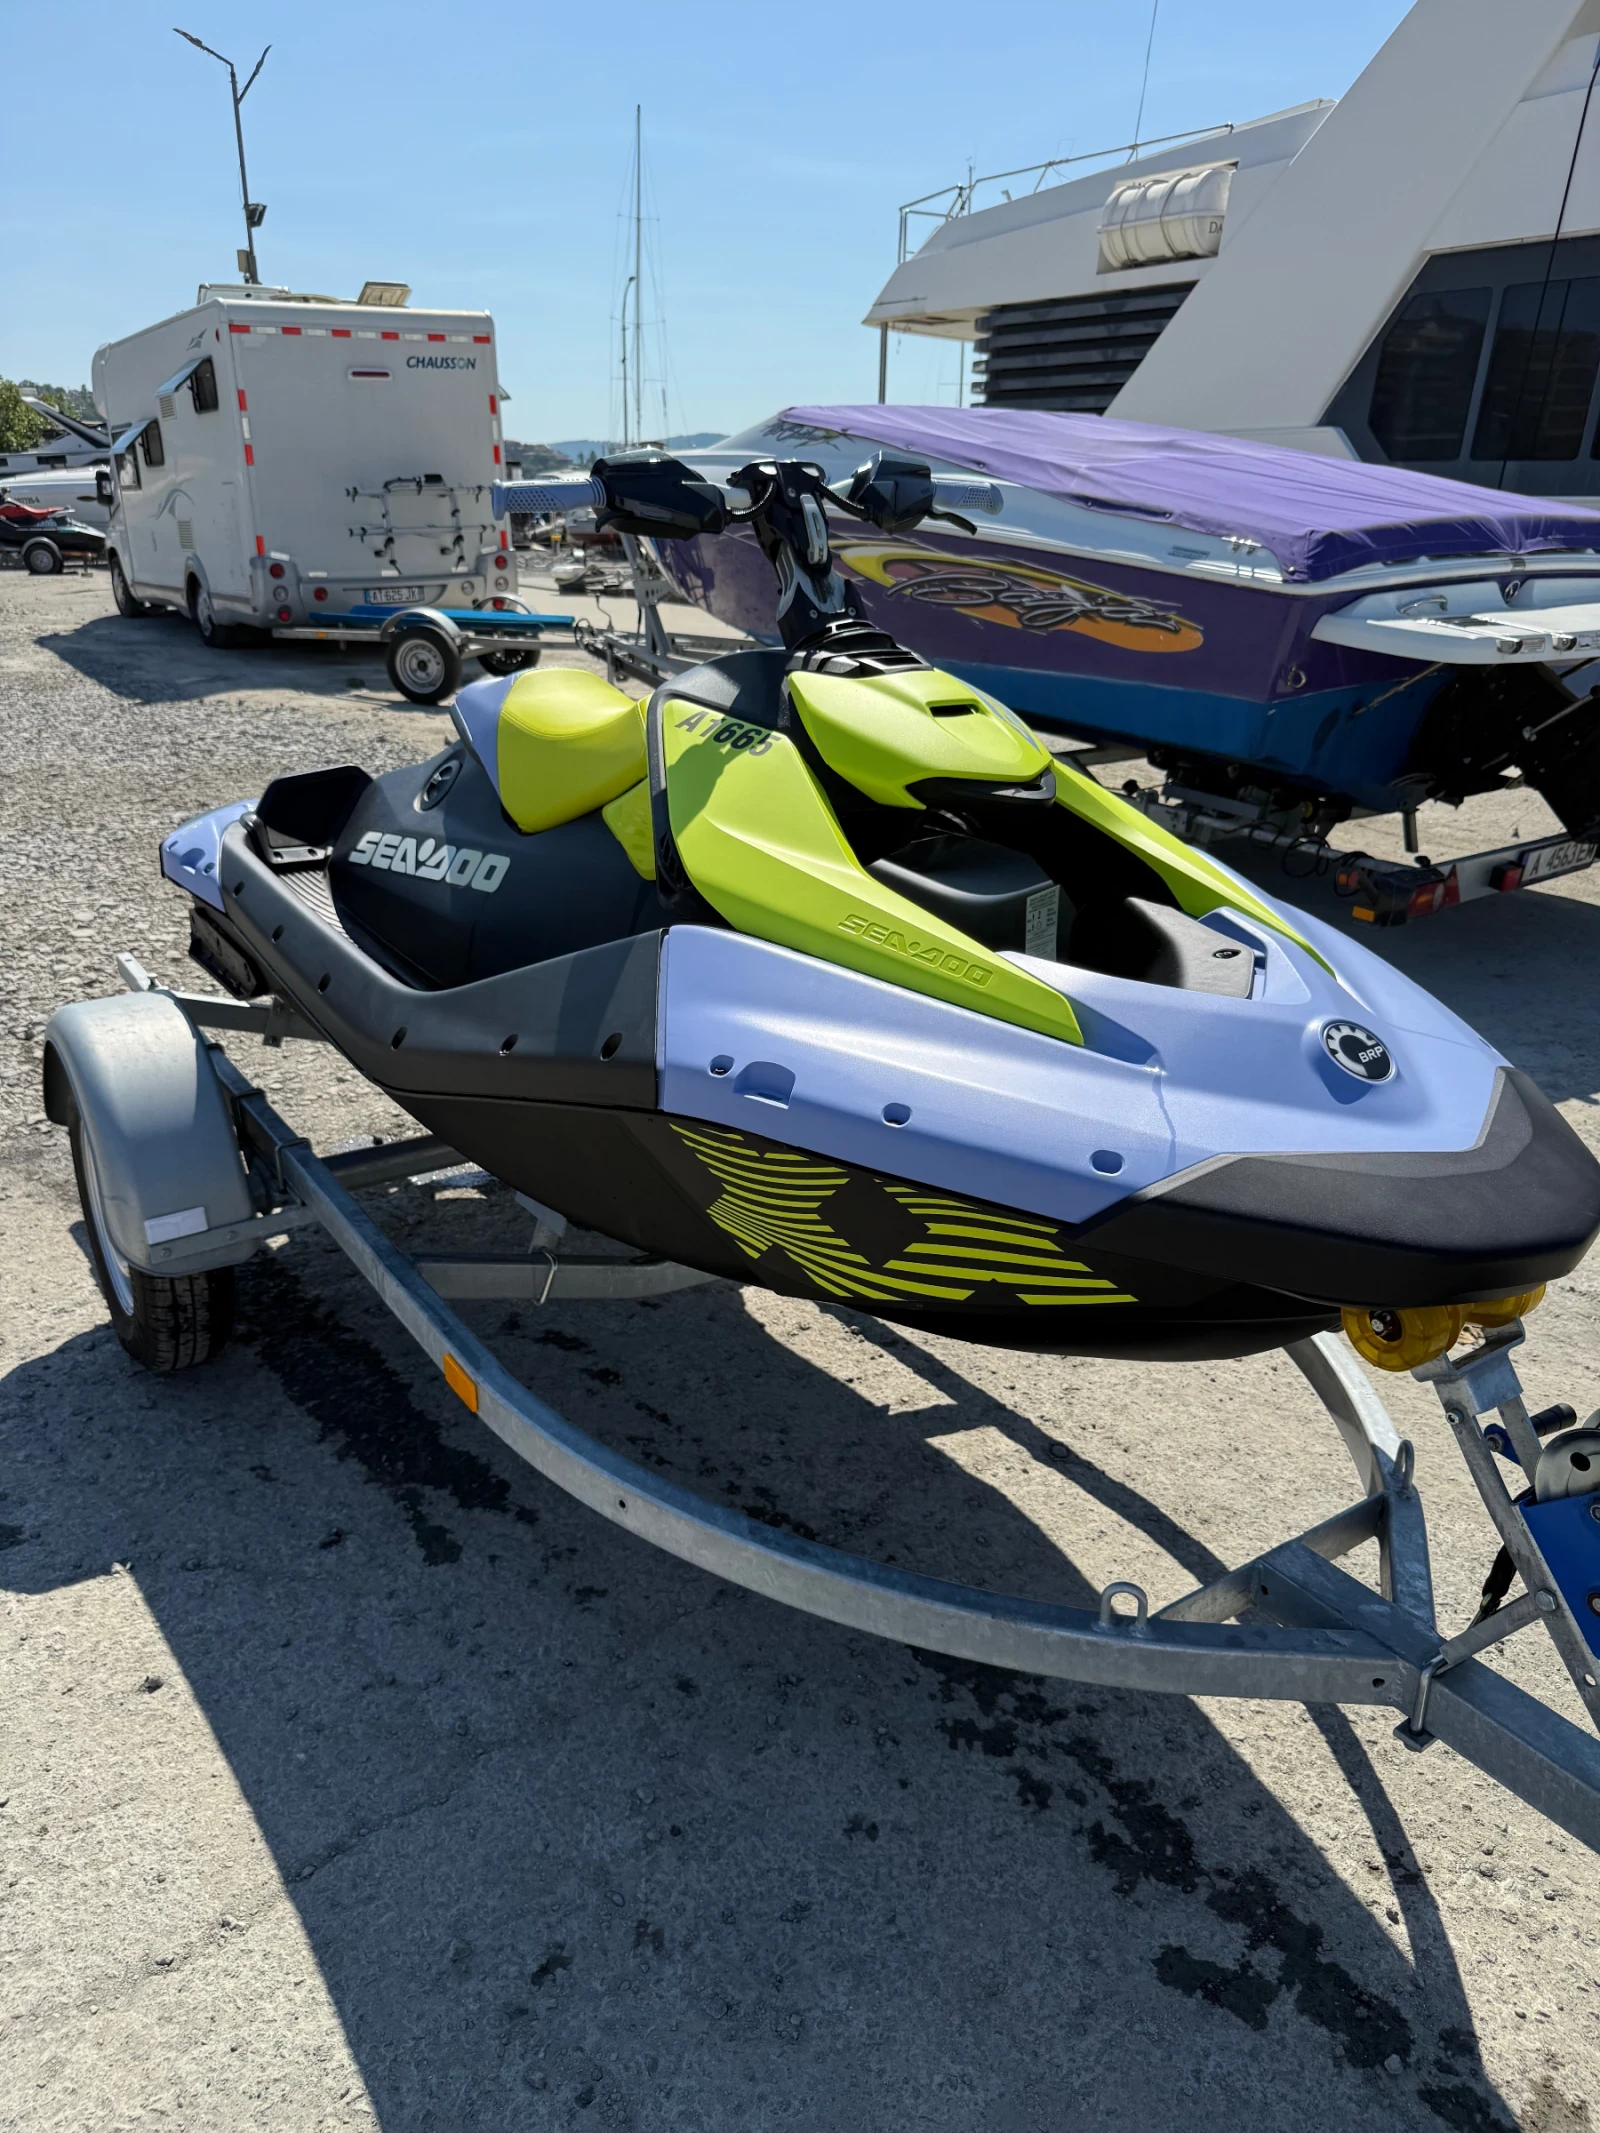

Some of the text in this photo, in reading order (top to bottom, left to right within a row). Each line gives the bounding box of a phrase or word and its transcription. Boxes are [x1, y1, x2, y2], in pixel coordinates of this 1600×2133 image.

[406, 355, 477, 371] CHAUSSON
[674, 710, 782, 756] A1665
[1530, 853, 1541, 876] A
[1357, 1045, 1383, 1064] BRP
